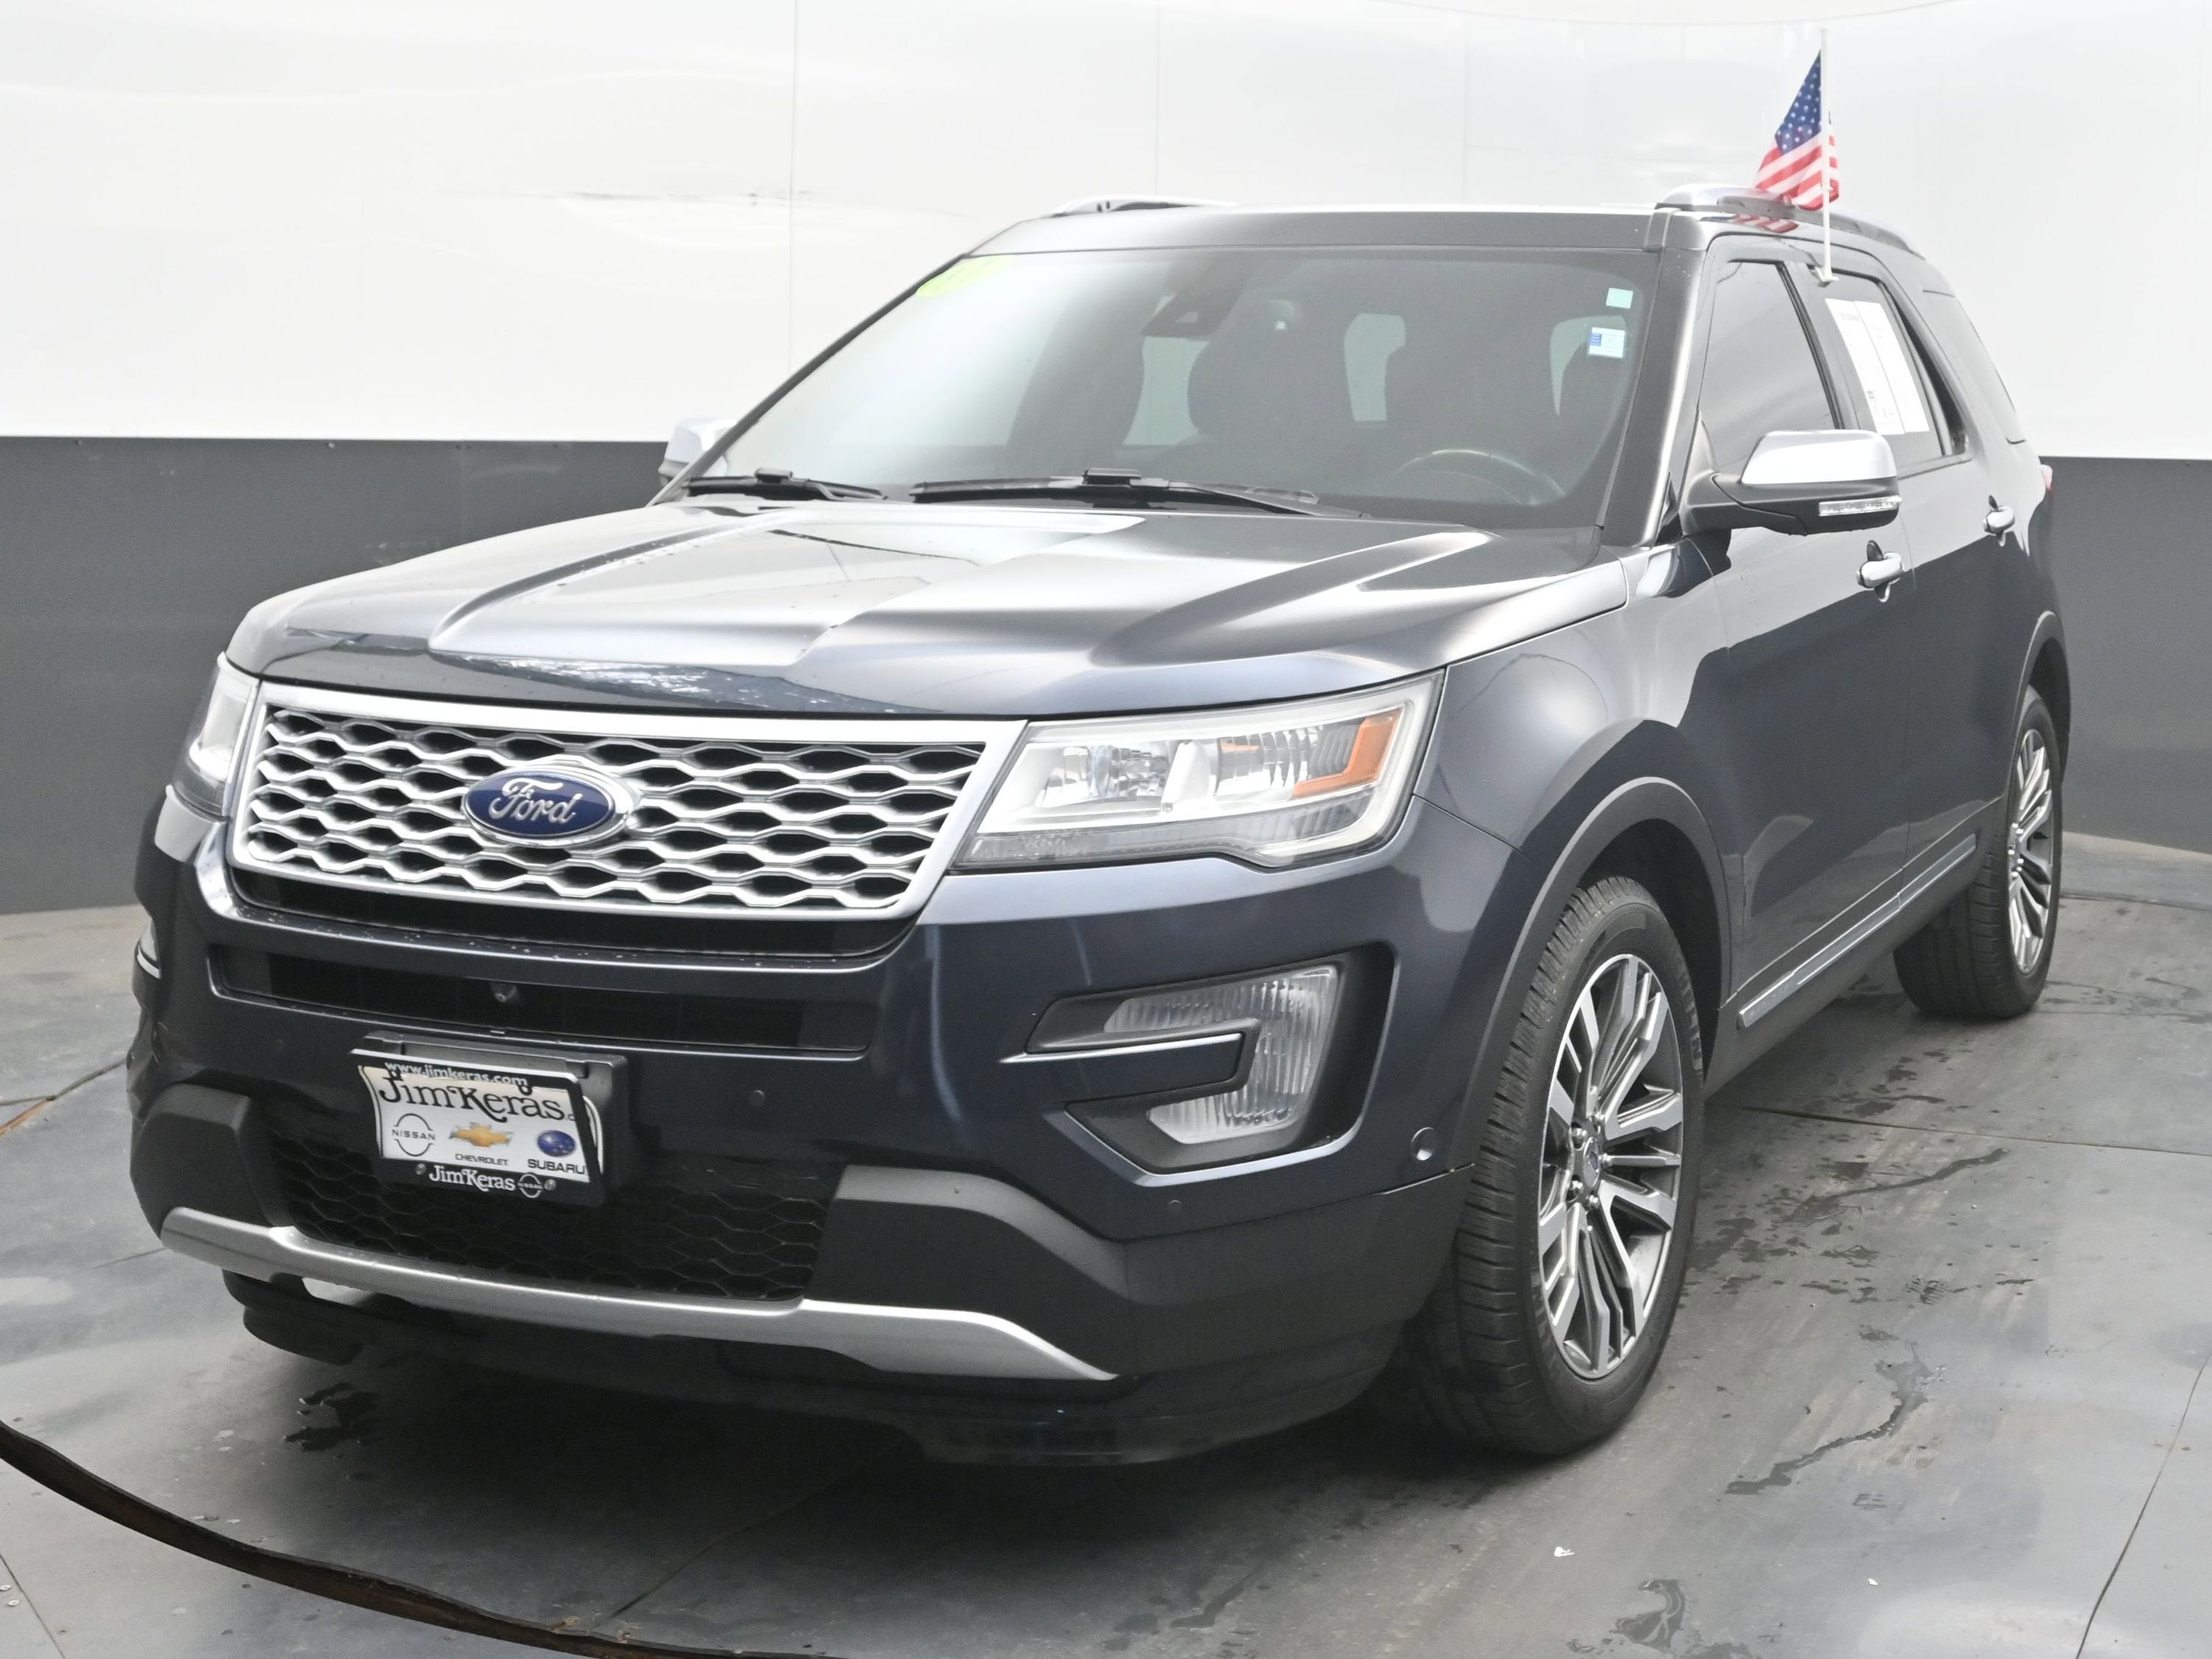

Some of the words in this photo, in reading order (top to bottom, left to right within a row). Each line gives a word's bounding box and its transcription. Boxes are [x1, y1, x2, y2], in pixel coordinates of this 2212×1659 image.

[489, 777, 582, 824] Ford
[385, 1062, 527, 1086] www.jimkeras.com
[392, 1130, 435, 1140] NISSAN
[455, 1153, 509, 1166] CHEVROLET
[527, 1158, 585, 1175] SUBARU
